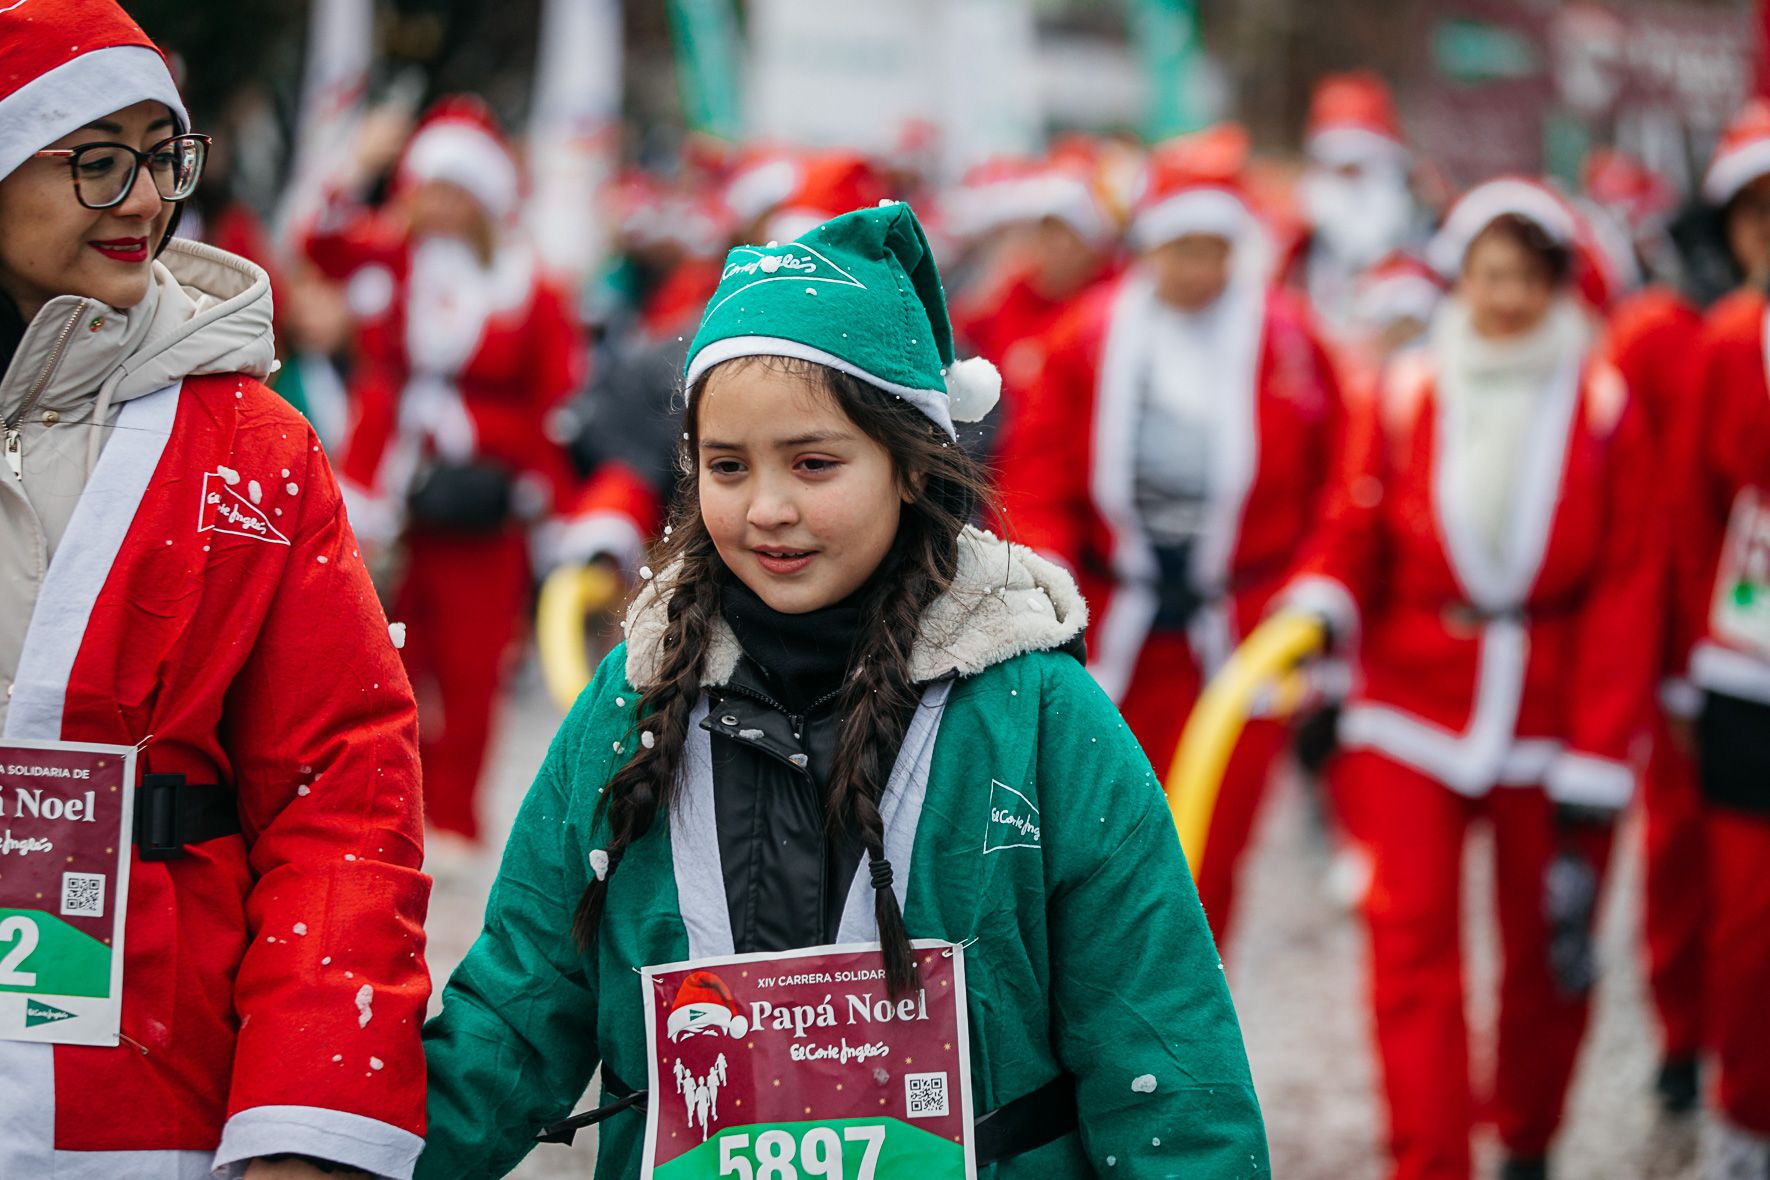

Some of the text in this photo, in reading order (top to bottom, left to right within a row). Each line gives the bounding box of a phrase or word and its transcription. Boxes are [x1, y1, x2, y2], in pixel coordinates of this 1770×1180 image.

[7, 764, 71, 778] SOLIDARIA
[73, 769, 90, 779] DE
[13, 788, 96, 822] Noel
[1020, 814, 1041, 841] Ing
[2, 829, 53, 856] Inglés
[757, 968, 886, 989] XIV CARRERA SOLIDAR
[749, 987, 930, 1039] Papá Noel
[790, 1037, 890, 1064] El Corte Inglés
[719, 1125, 886, 1180] 5897
